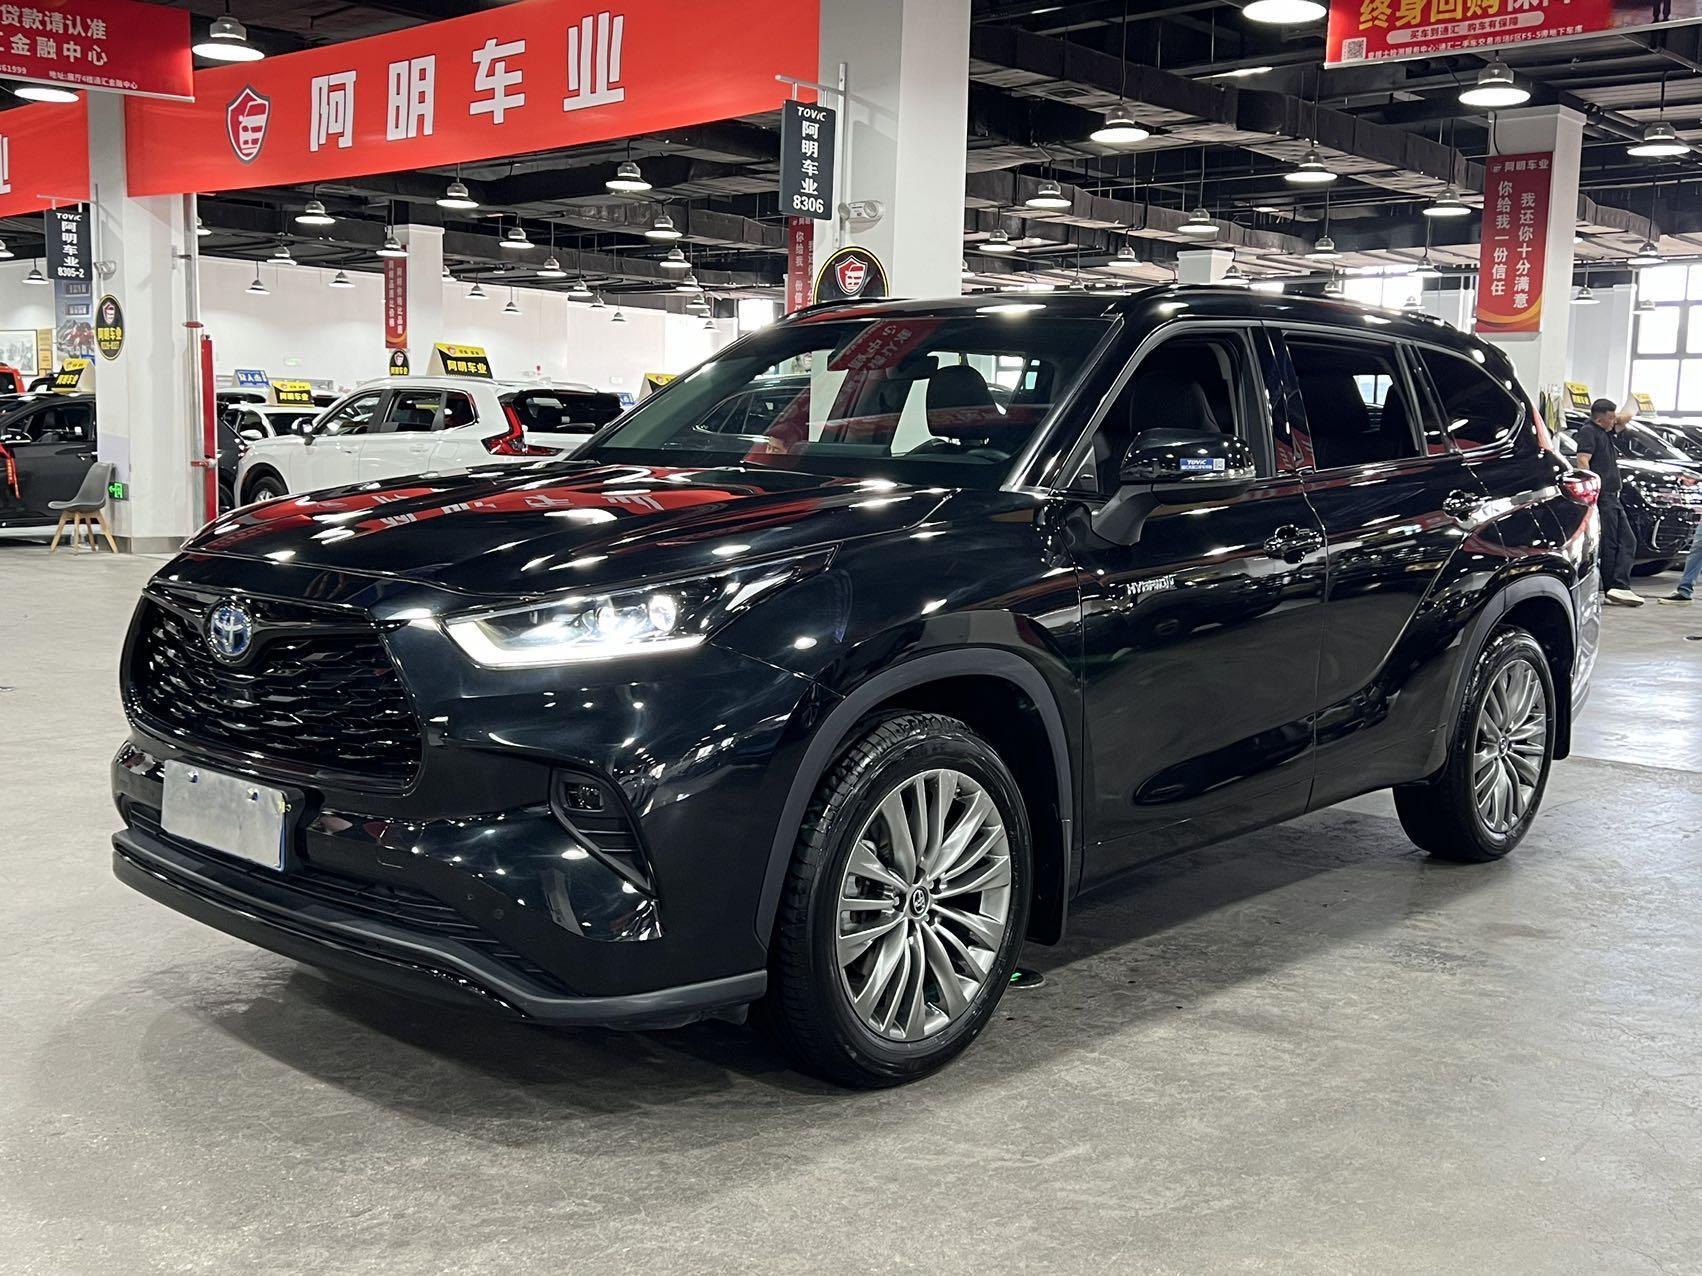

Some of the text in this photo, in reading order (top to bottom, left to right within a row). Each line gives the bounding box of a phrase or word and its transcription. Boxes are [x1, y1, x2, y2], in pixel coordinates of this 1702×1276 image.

[1409, 16, 1519, 40] 买车到通汇 购车有保障
[0, 31, 108, 66] 金融中心
[309, 11, 626, 152] 阿明车业
[800, 120, 819, 196] 阿明车业
[1504, 159, 1550, 172] 阿明车业
[792, 195, 824, 213] 8306
[61, 221, 80, 268] 阿明车业
[1490, 181, 1513, 297] 你给我一份信任
[1512, 192, 1536, 309] 我还你十分满意
[57, 267, 85, 279] 8305-2
[446, 359, 488, 375] 阿明车业
